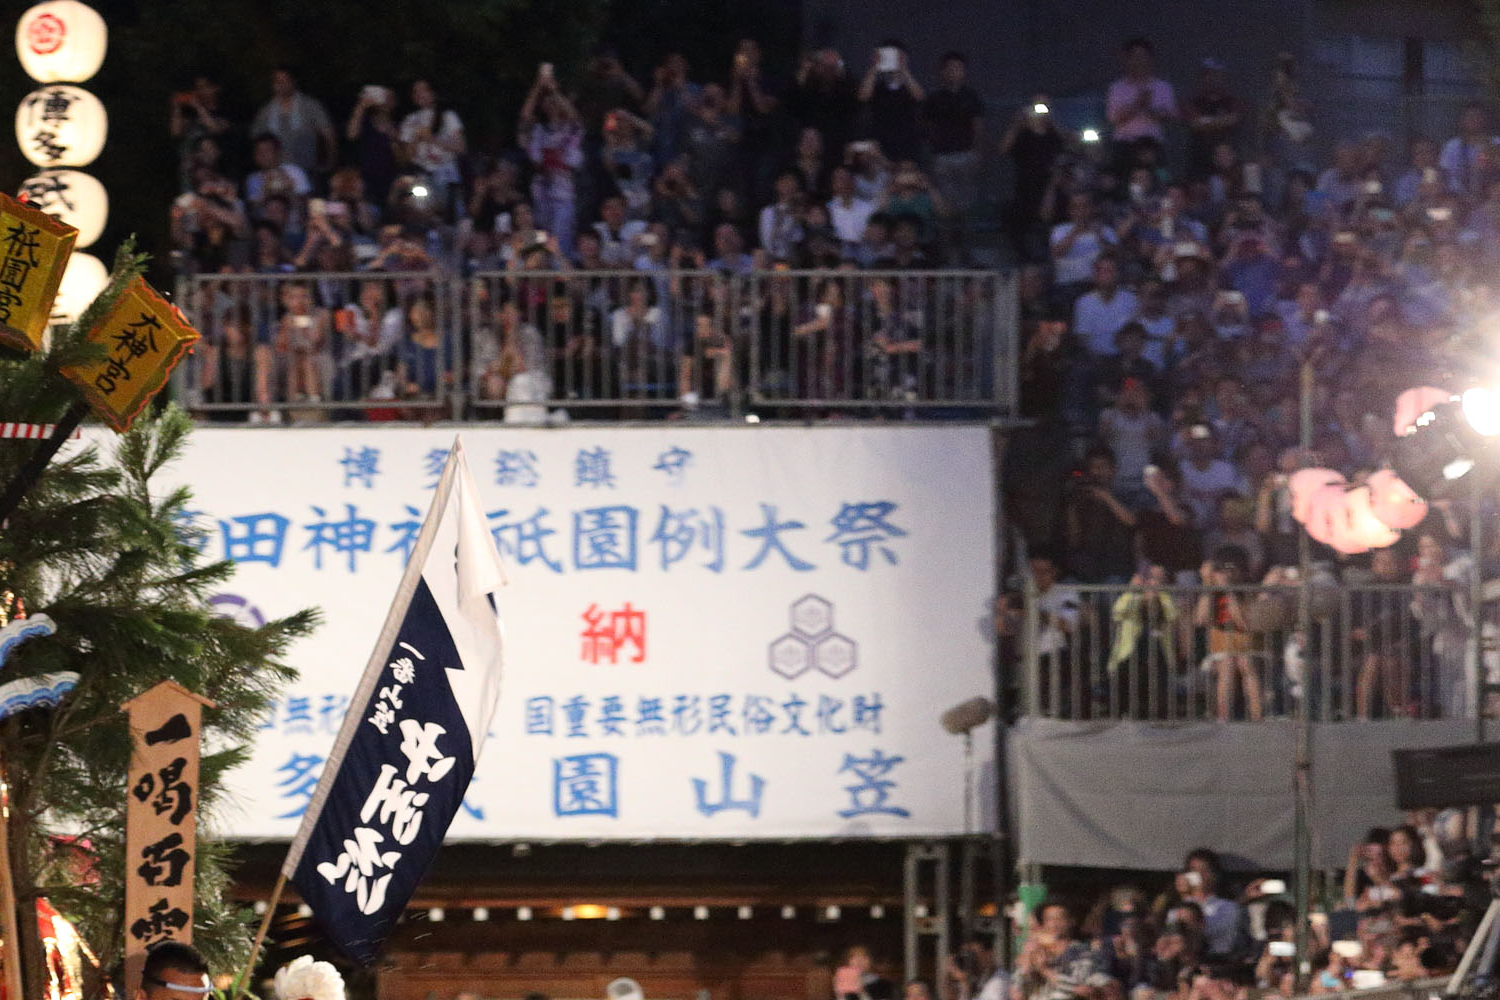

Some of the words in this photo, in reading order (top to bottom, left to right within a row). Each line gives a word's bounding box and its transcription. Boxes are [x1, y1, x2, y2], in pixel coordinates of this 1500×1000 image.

[95, 312, 162, 395] 大神宮
[172, 500, 910, 576] 田神祇園例大祭
[579, 602, 647, 664] 納
[524, 692, 886, 738] 国重要無形民俗文化財
